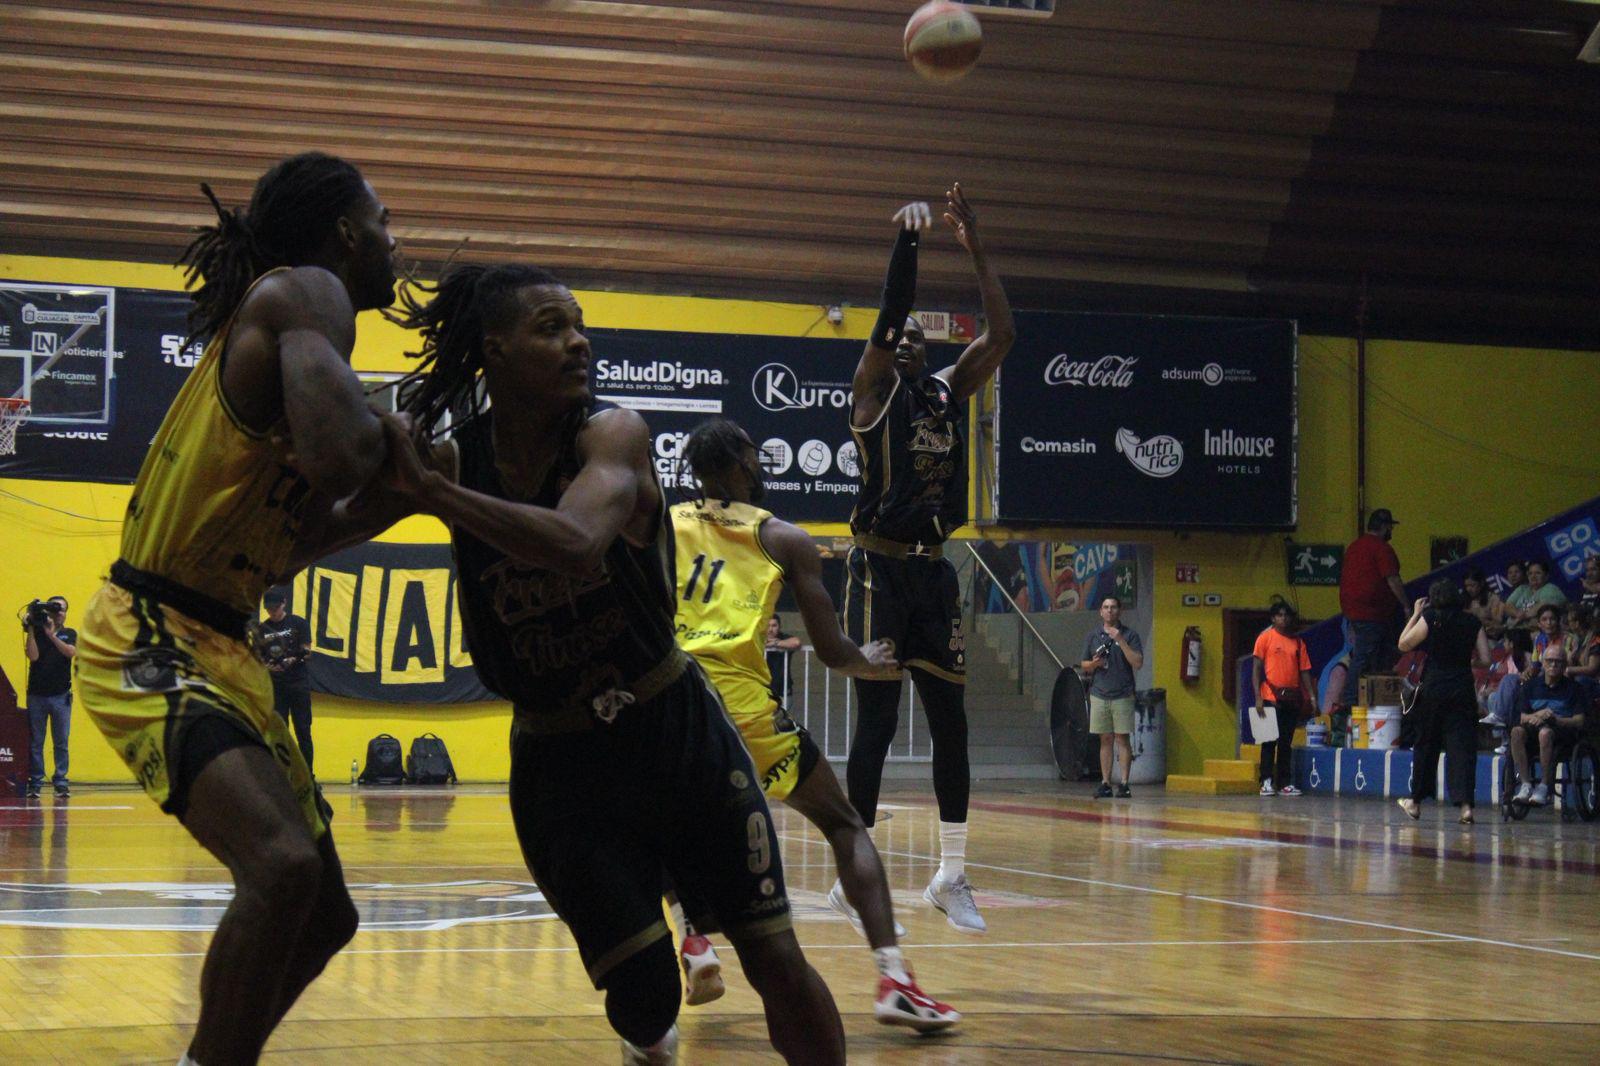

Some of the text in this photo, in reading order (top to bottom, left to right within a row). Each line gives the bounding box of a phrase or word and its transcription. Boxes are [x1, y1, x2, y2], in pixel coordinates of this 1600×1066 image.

[51, 370, 97, 381] Fincamex
[596, 360, 723, 389] SaludDigna
[1161, 368, 1203, 380] adsum
[1020, 436, 1097, 454] Comasin
[1134, 439, 1174, 459] nutri
[1204, 428, 1275, 457] InHouse
[1148, 454, 1179, 470] rica
[1217, 465, 1261, 474] HOTELS
[804, 481, 812, 493] y
[1550, 523, 1592, 553] GO
[1074, 544, 1118, 580] CAVS
[682, 553, 726, 604] 11
[746, 811, 771, 875] 9
